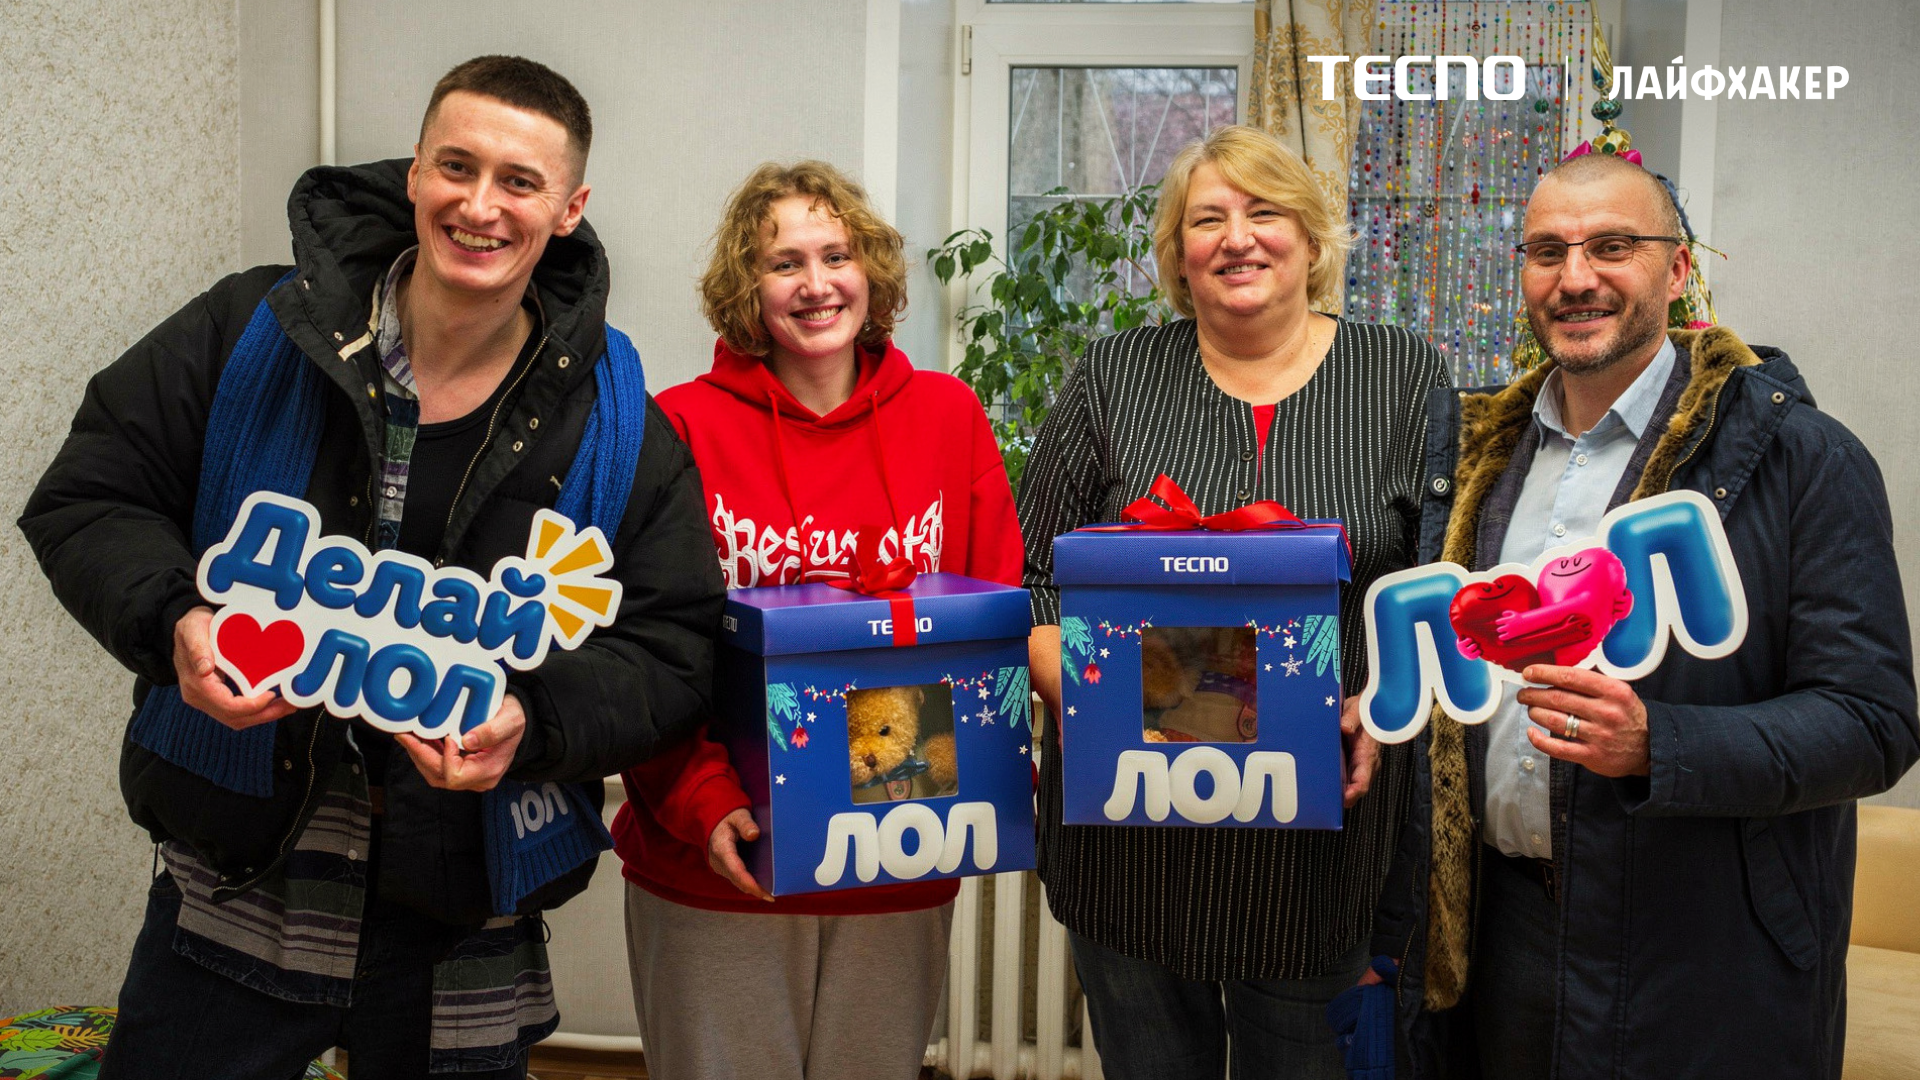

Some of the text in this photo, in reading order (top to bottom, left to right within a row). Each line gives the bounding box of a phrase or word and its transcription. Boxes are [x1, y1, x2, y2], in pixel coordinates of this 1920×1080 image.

[1160, 556, 1229, 572] TECNO
[207, 501, 547, 660] Делай
[867, 617, 933, 636] TEO
